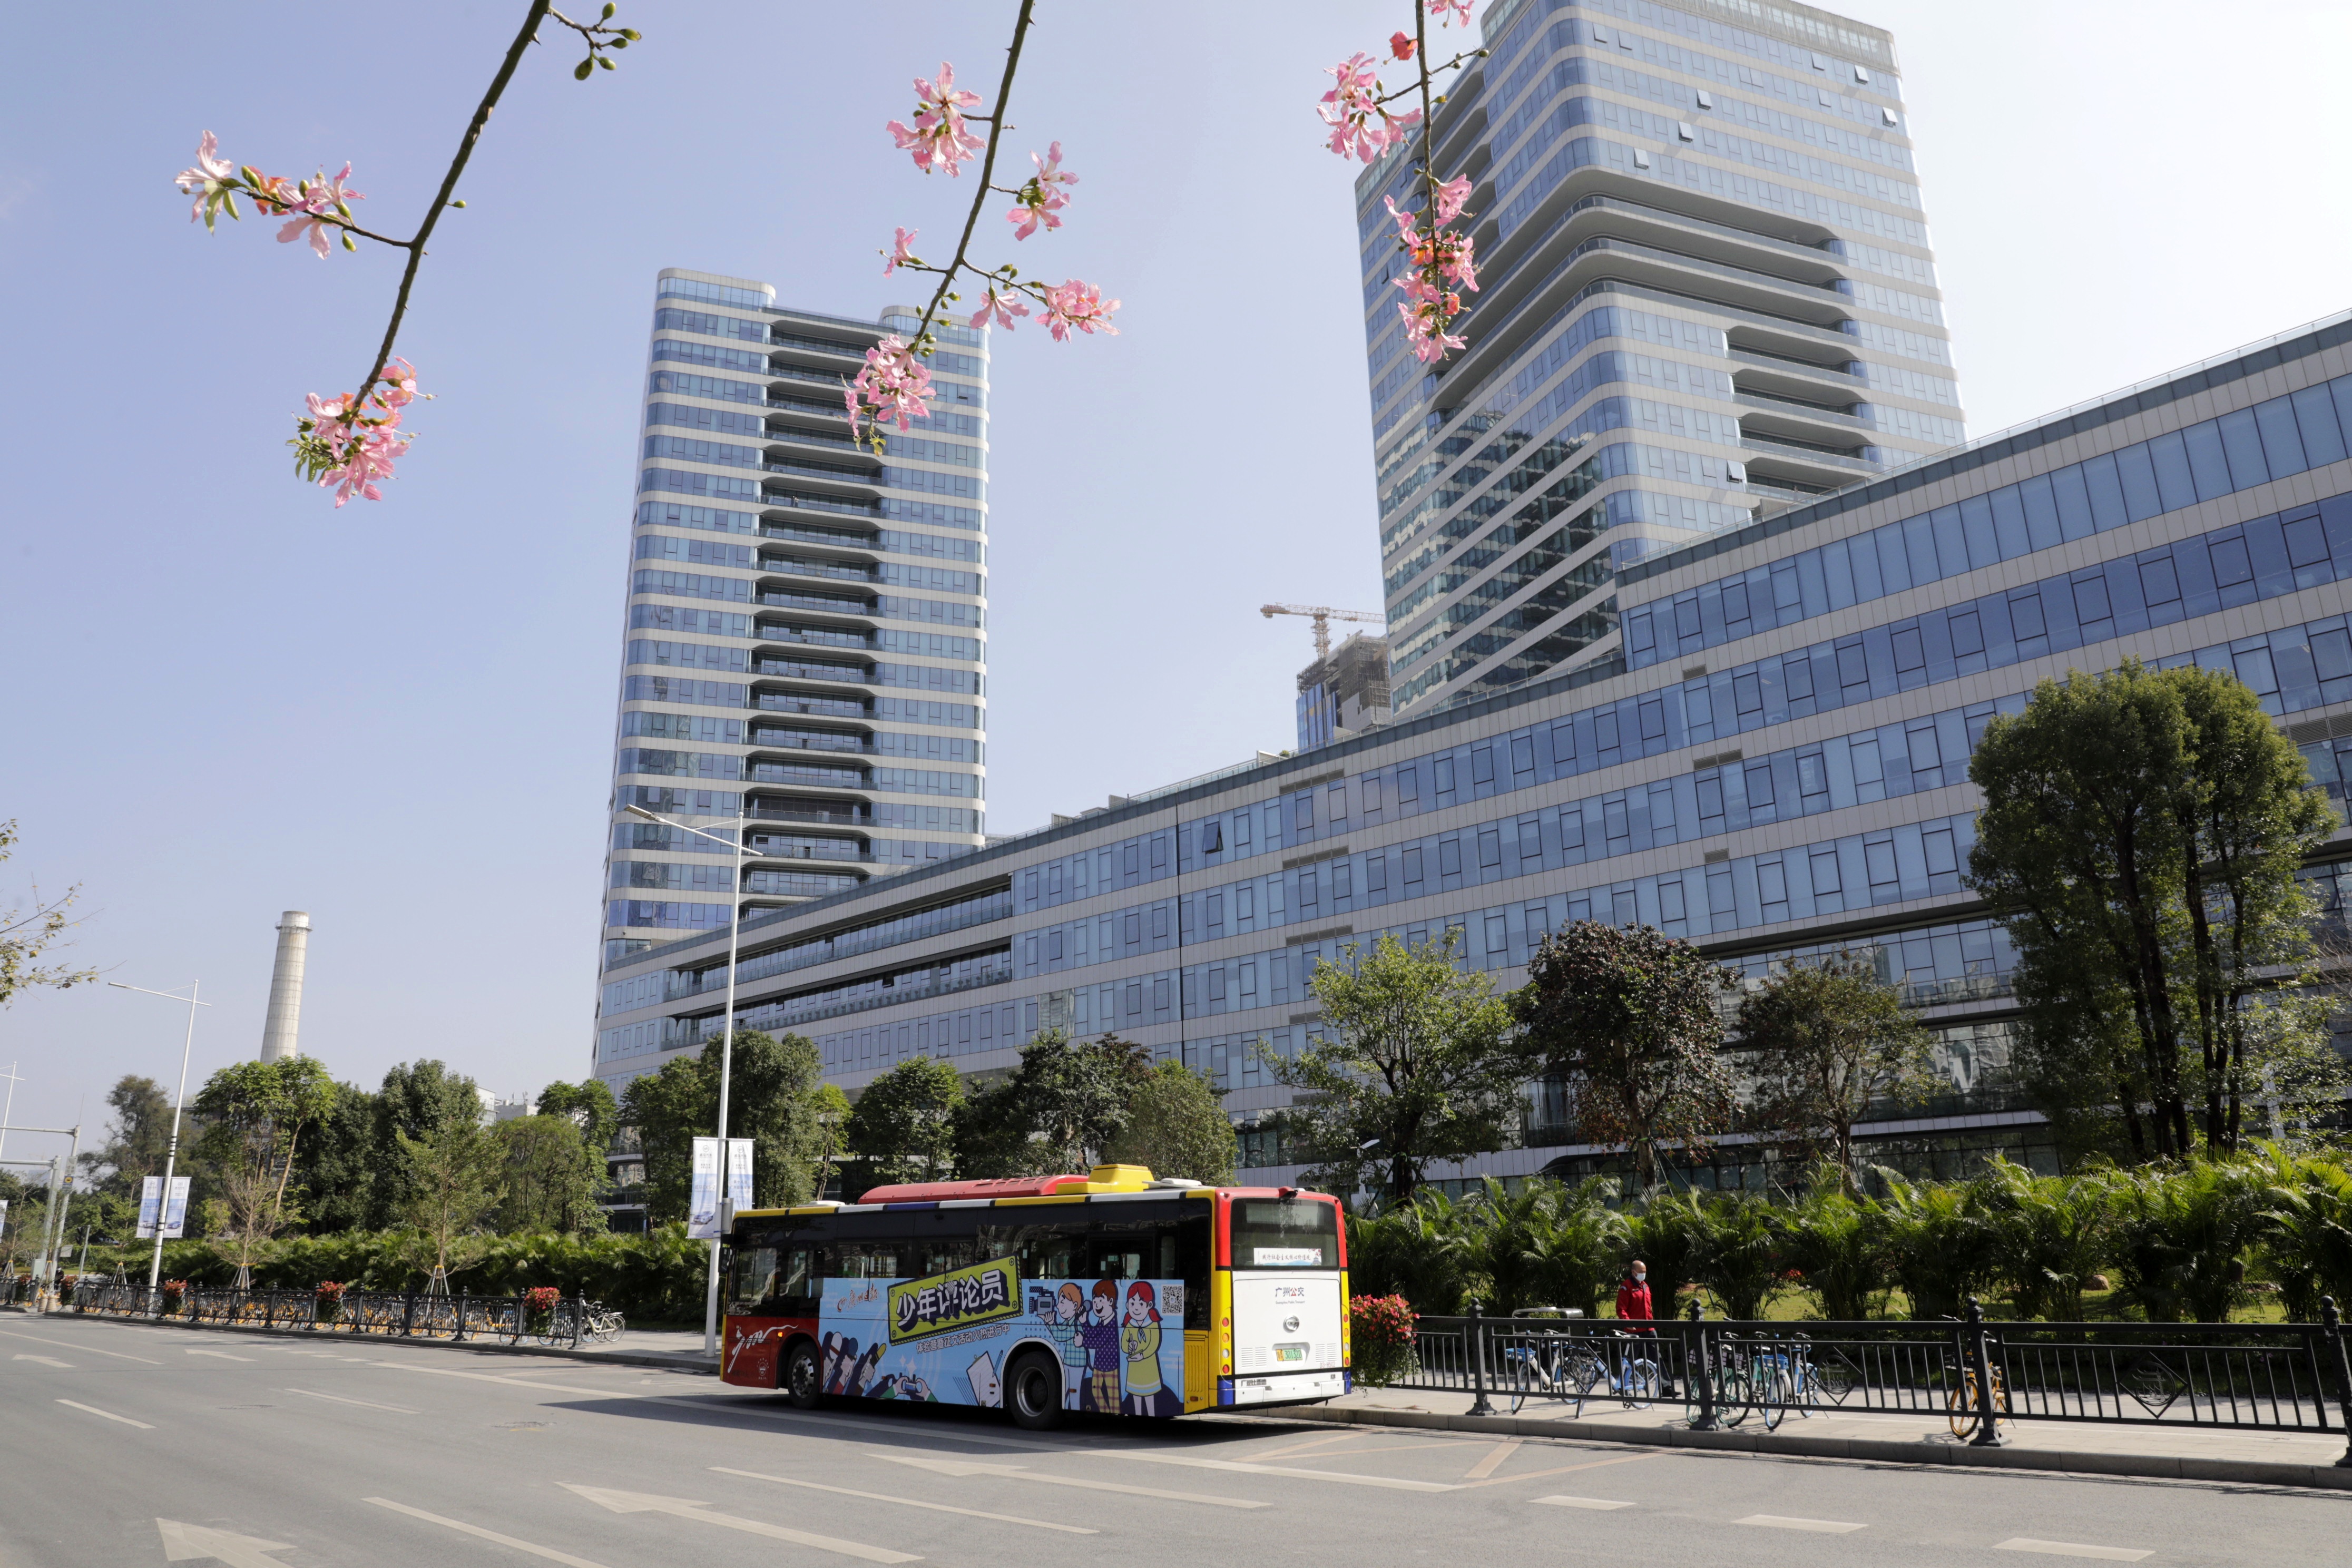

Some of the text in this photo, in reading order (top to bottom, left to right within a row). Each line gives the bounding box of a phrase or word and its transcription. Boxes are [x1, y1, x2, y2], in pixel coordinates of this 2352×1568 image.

[896, 1269, 1004, 1327] 少年评论员
[1275, 1287, 1305, 1297] 广州公交
[916, 1323, 1010, 1354] 体验营暨征文活动火热进行中
